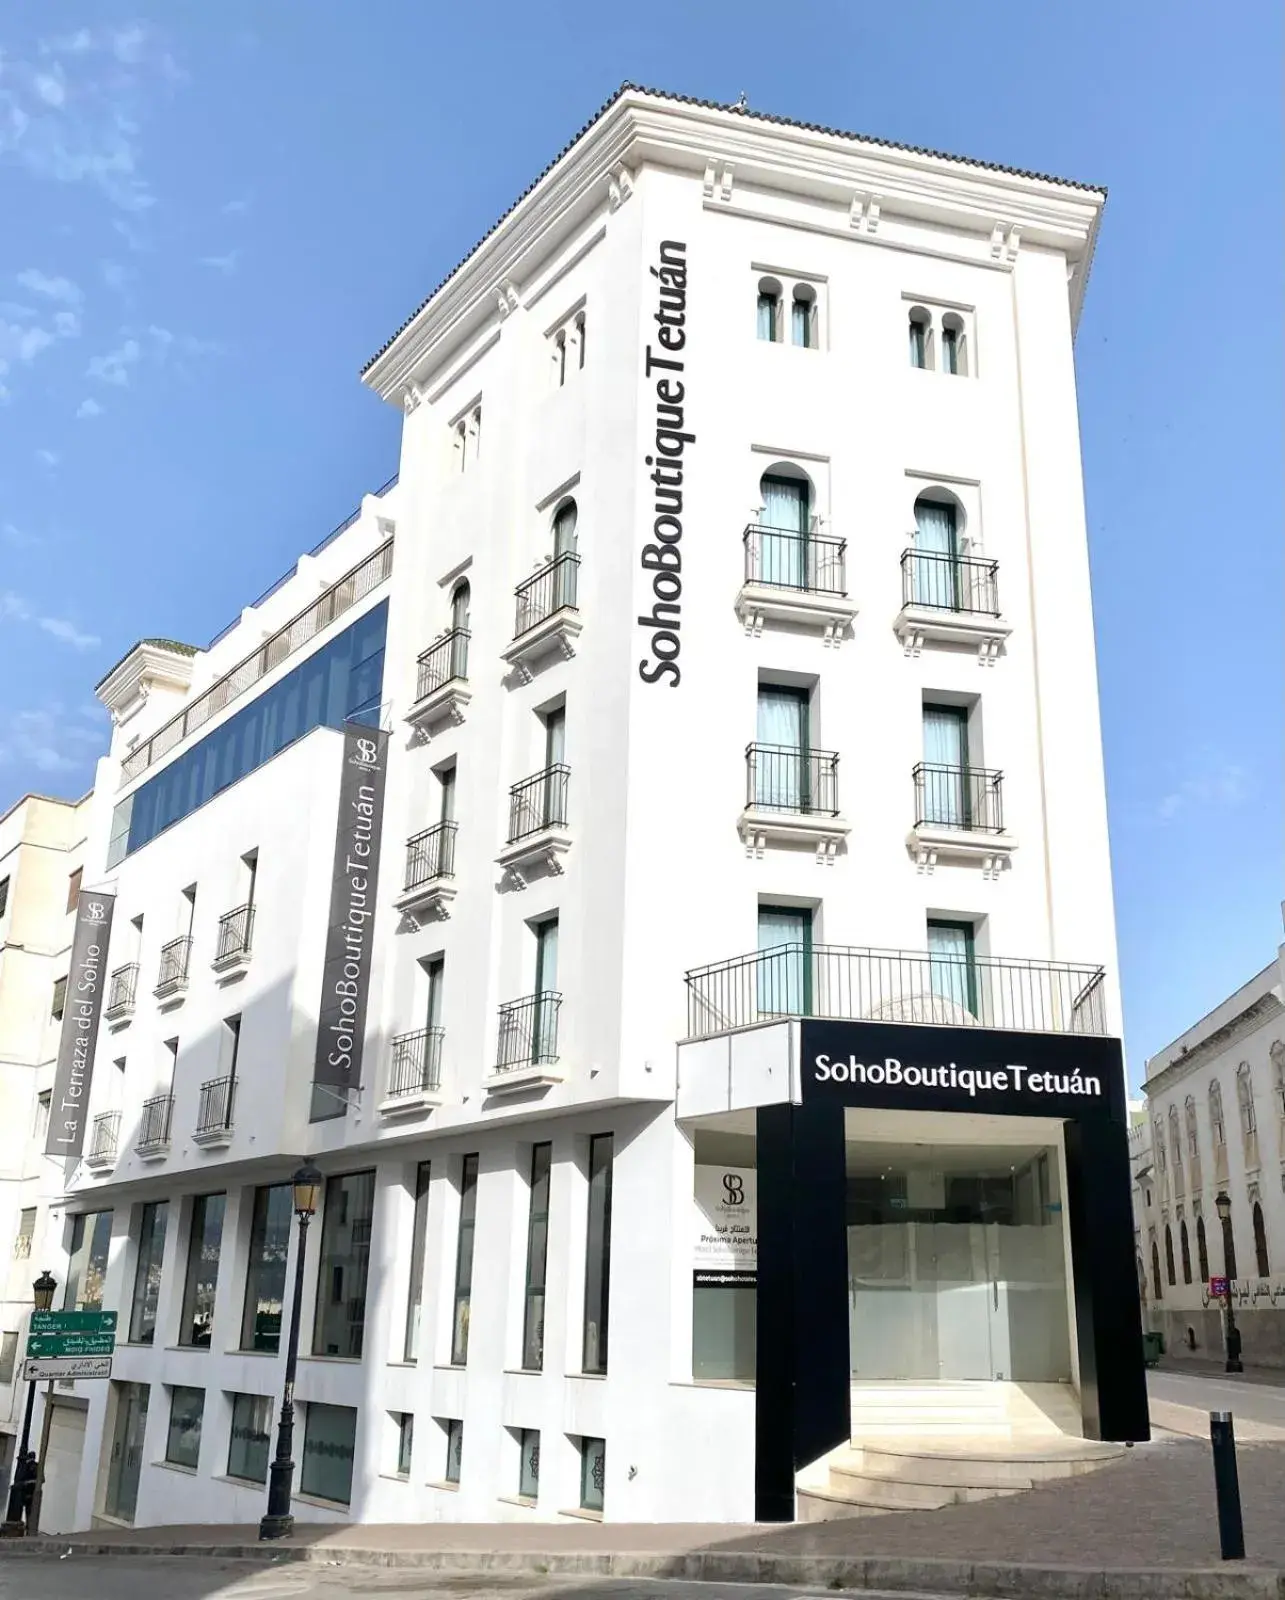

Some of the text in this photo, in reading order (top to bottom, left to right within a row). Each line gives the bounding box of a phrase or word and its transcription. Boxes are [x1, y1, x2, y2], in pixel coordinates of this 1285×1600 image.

[639, 241, 695, 688] SohoBoutiqueTetuán
[329, 786, 375, 1069] SohoBoutiqueTetuán
[78, 945, 101, 993] Soho
[72, 998, 94, 1030] del
[61, 1037, 90, 1108] Terraza
[815, 1054, 1101, 1096] SohoBoutiqueTetuán
[57, 1119, 78, 1144] La
[700, 1233, 732, 1244] Próxima
